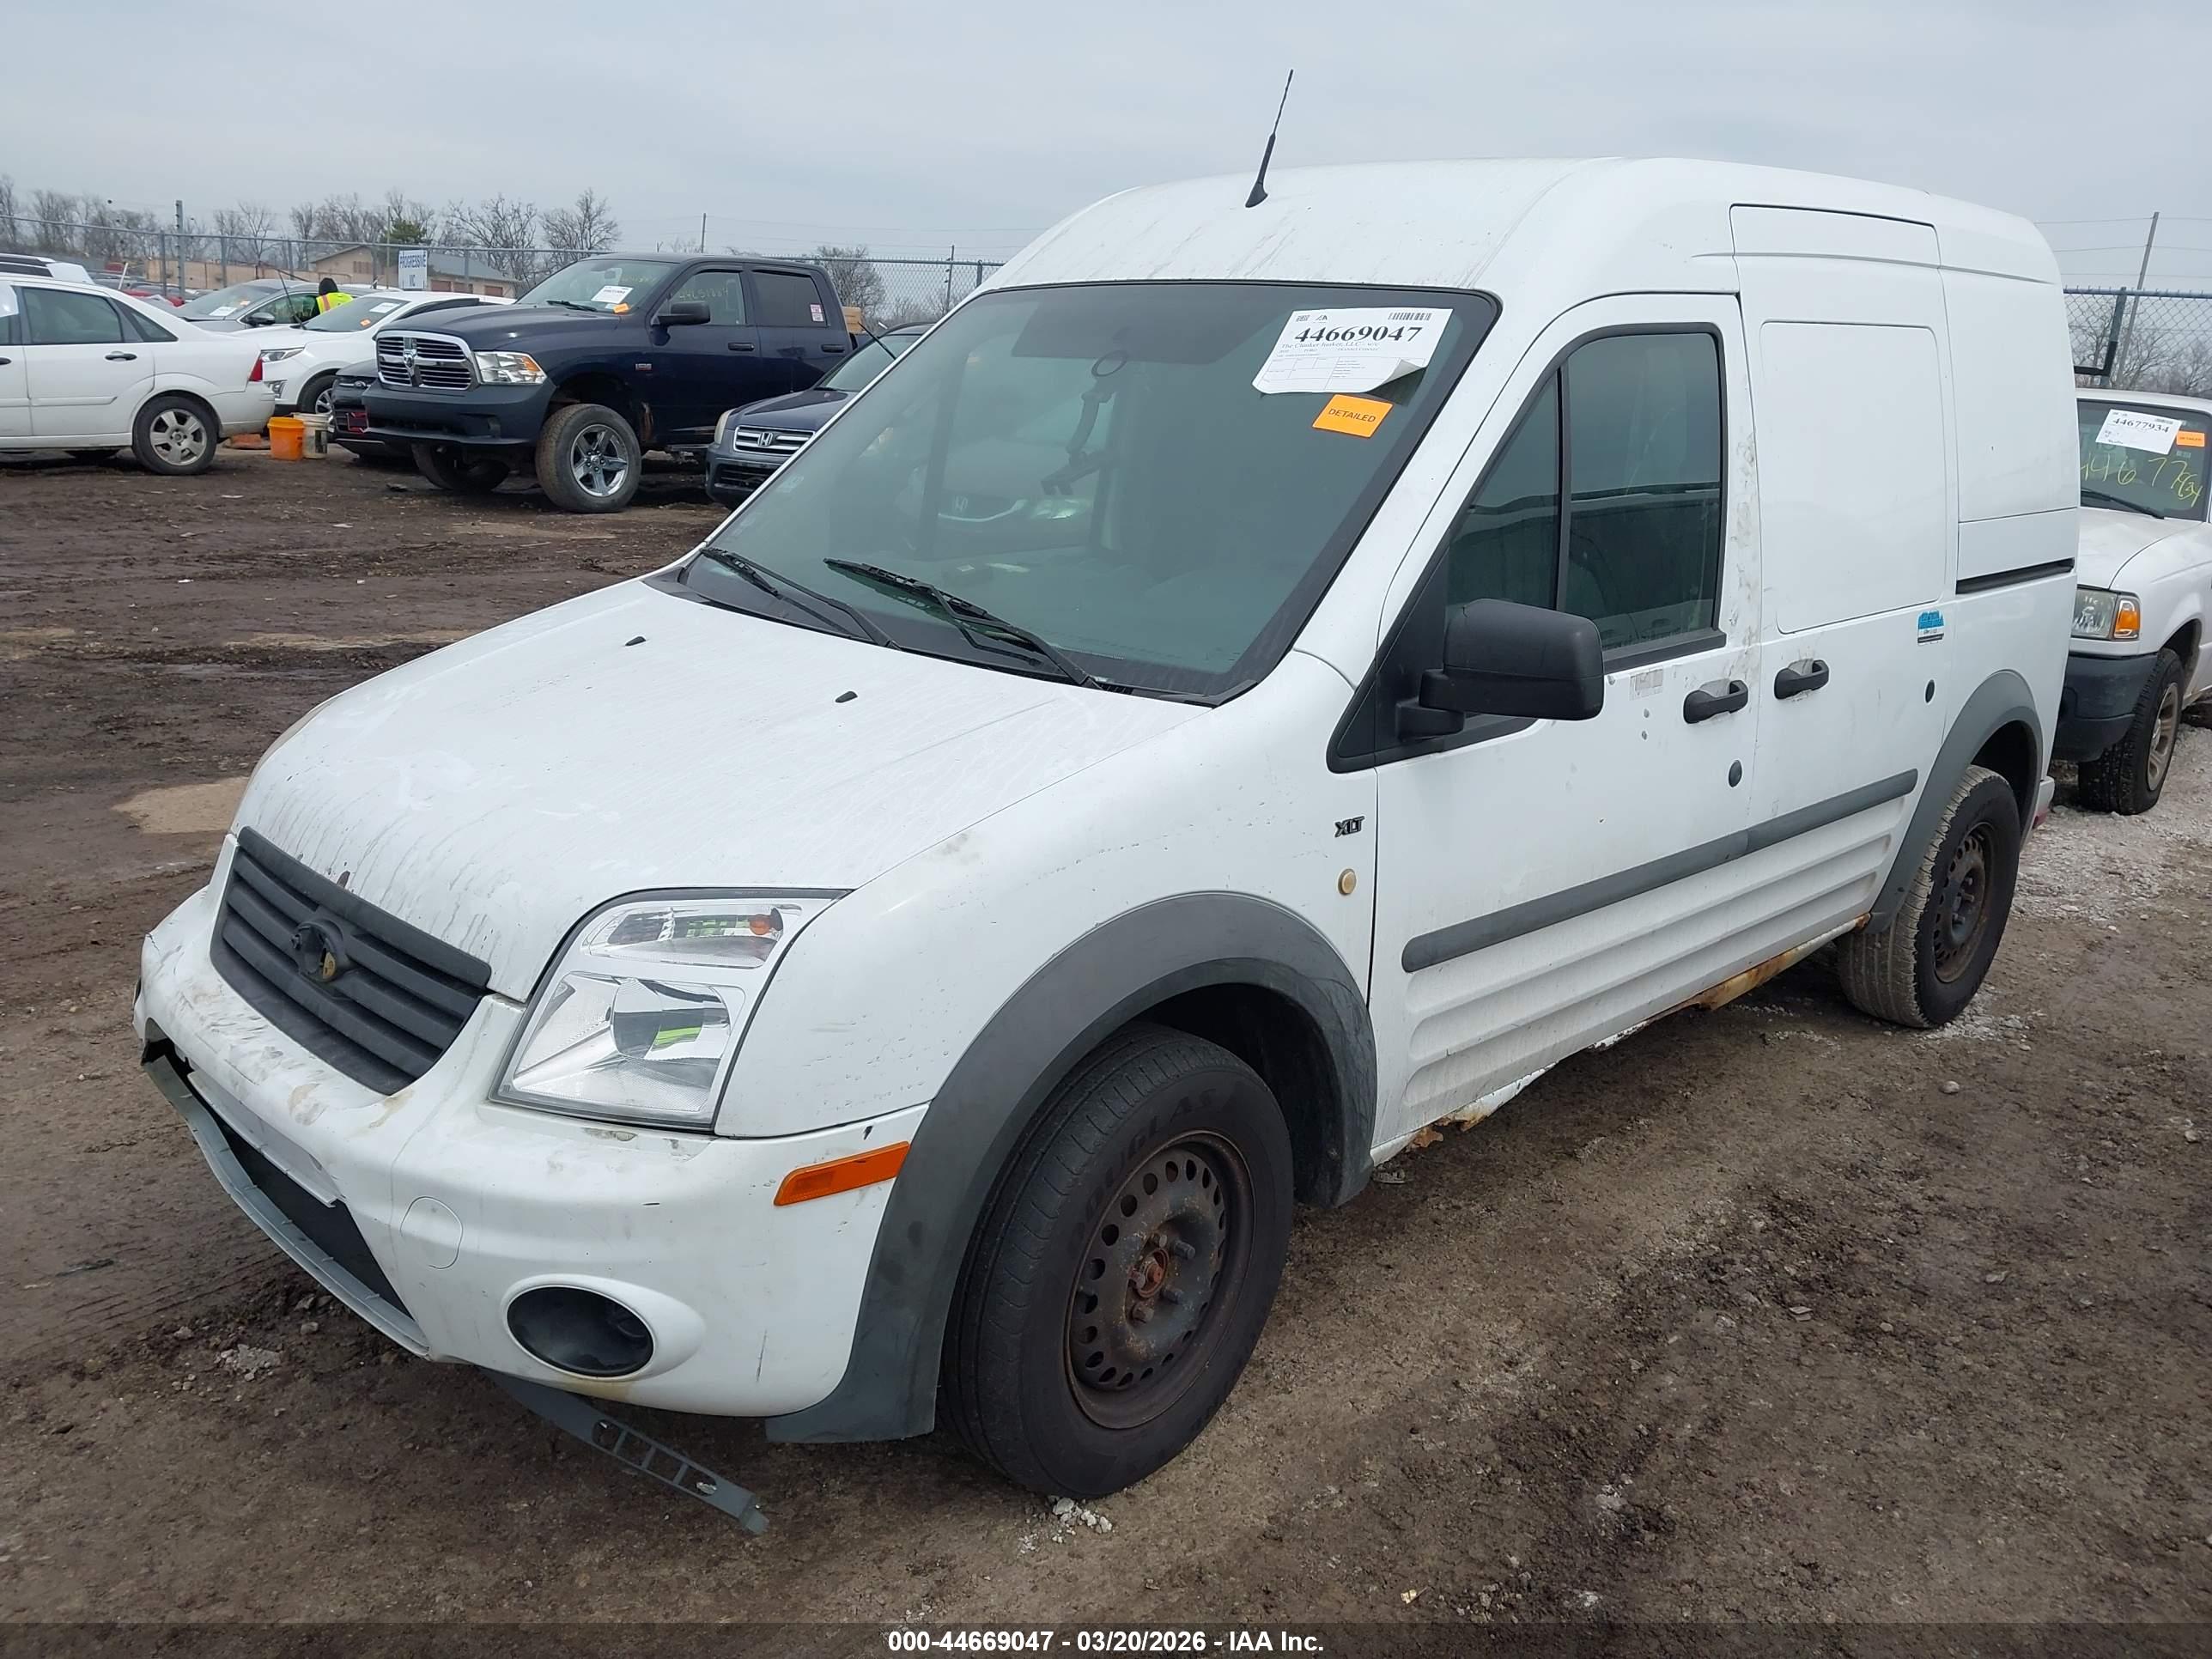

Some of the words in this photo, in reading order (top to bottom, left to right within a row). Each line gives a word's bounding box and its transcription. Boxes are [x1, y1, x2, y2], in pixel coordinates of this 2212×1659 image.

[399, 254, 427, 268] PROGRESSIVE
[1295, 325, 1423, 343] 44669047
[1328, 408, 1376, 422] DETAILED
[2112, 417, 2170, 433] 44677934
[1334, 816, 1365, 838] XLT
